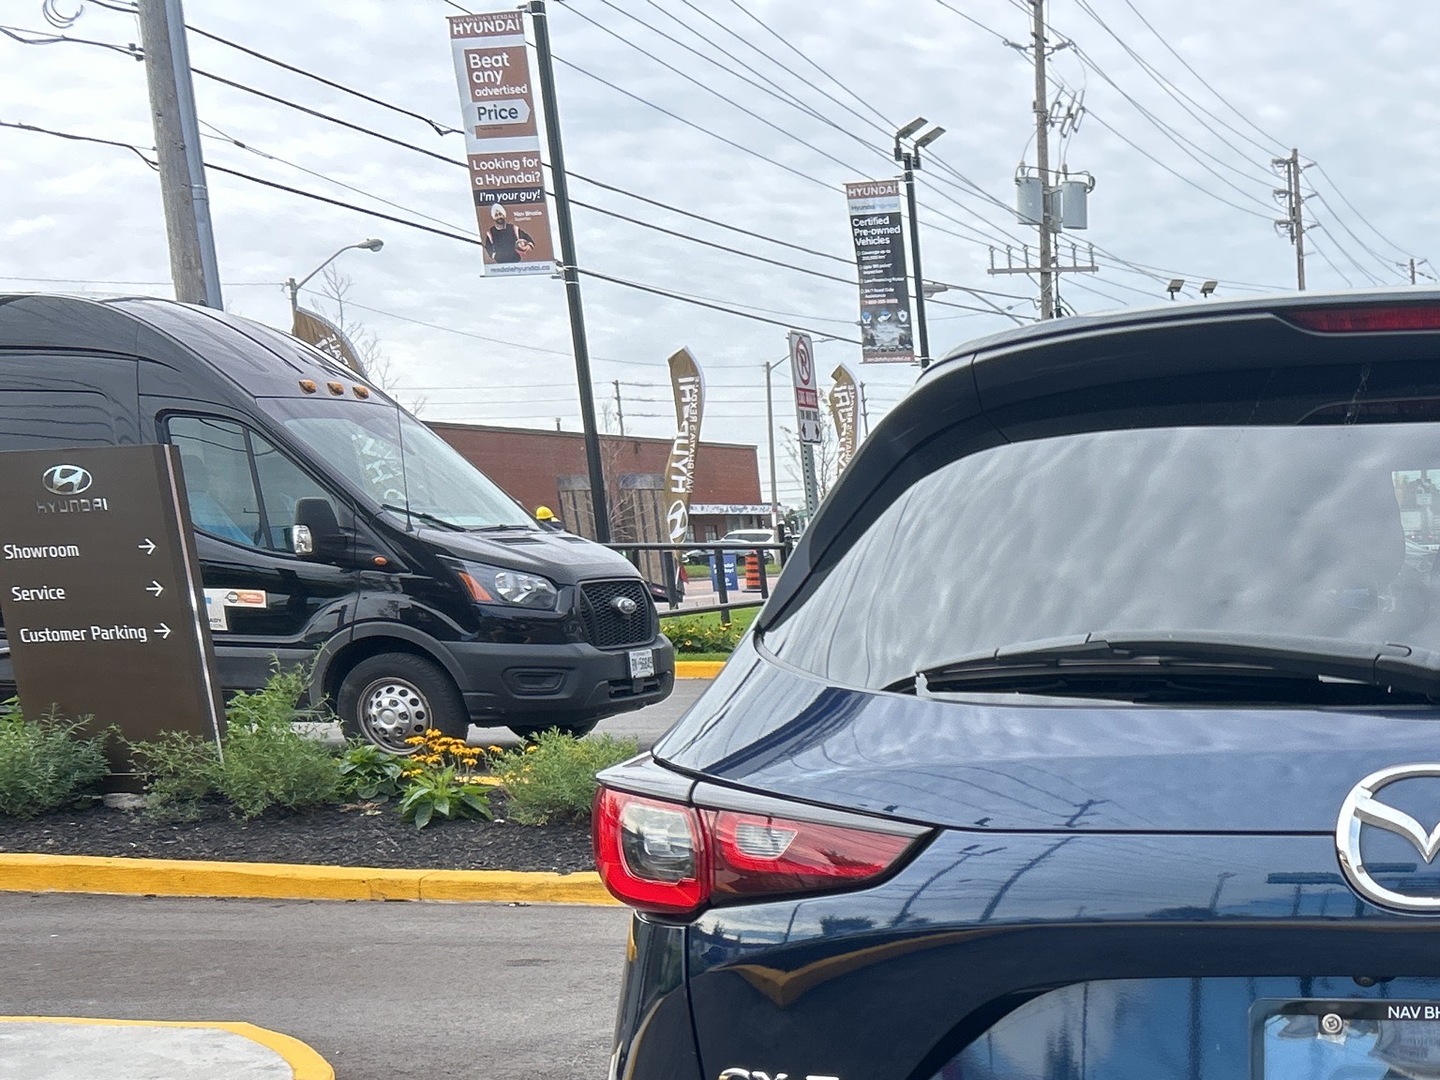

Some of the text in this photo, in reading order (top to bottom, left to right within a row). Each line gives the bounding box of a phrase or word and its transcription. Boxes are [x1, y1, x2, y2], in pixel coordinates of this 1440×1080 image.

[453, 19, 521, 35] HYUNDAI
[468, 52, 510, 69] Beat
[472, 69, 503, 85] any
[475, 84, 528, 97] advertised
[477, 104, 519, 121] Price
[473, 157, 539, 171] Looking for
[475, 172, 541, 187] a Hyundai?
[479, 190, 541, 203] I'm your guy!
[848, 184, 897, 197] HYUNDAI
[852, 216, 890, 227] Certified
[853, 225, 901, 237] Pre-owned
[855, 236, 891, 246] Vehicles
[36, 498, 108, 514] HYUNDAI
[4, 544, 80, 560] Showroom
[11, 585, 66, 602] Service
[20, 625, 148, 643] Customer Parking
[1388, 1005, 1421, 1020] NAV
